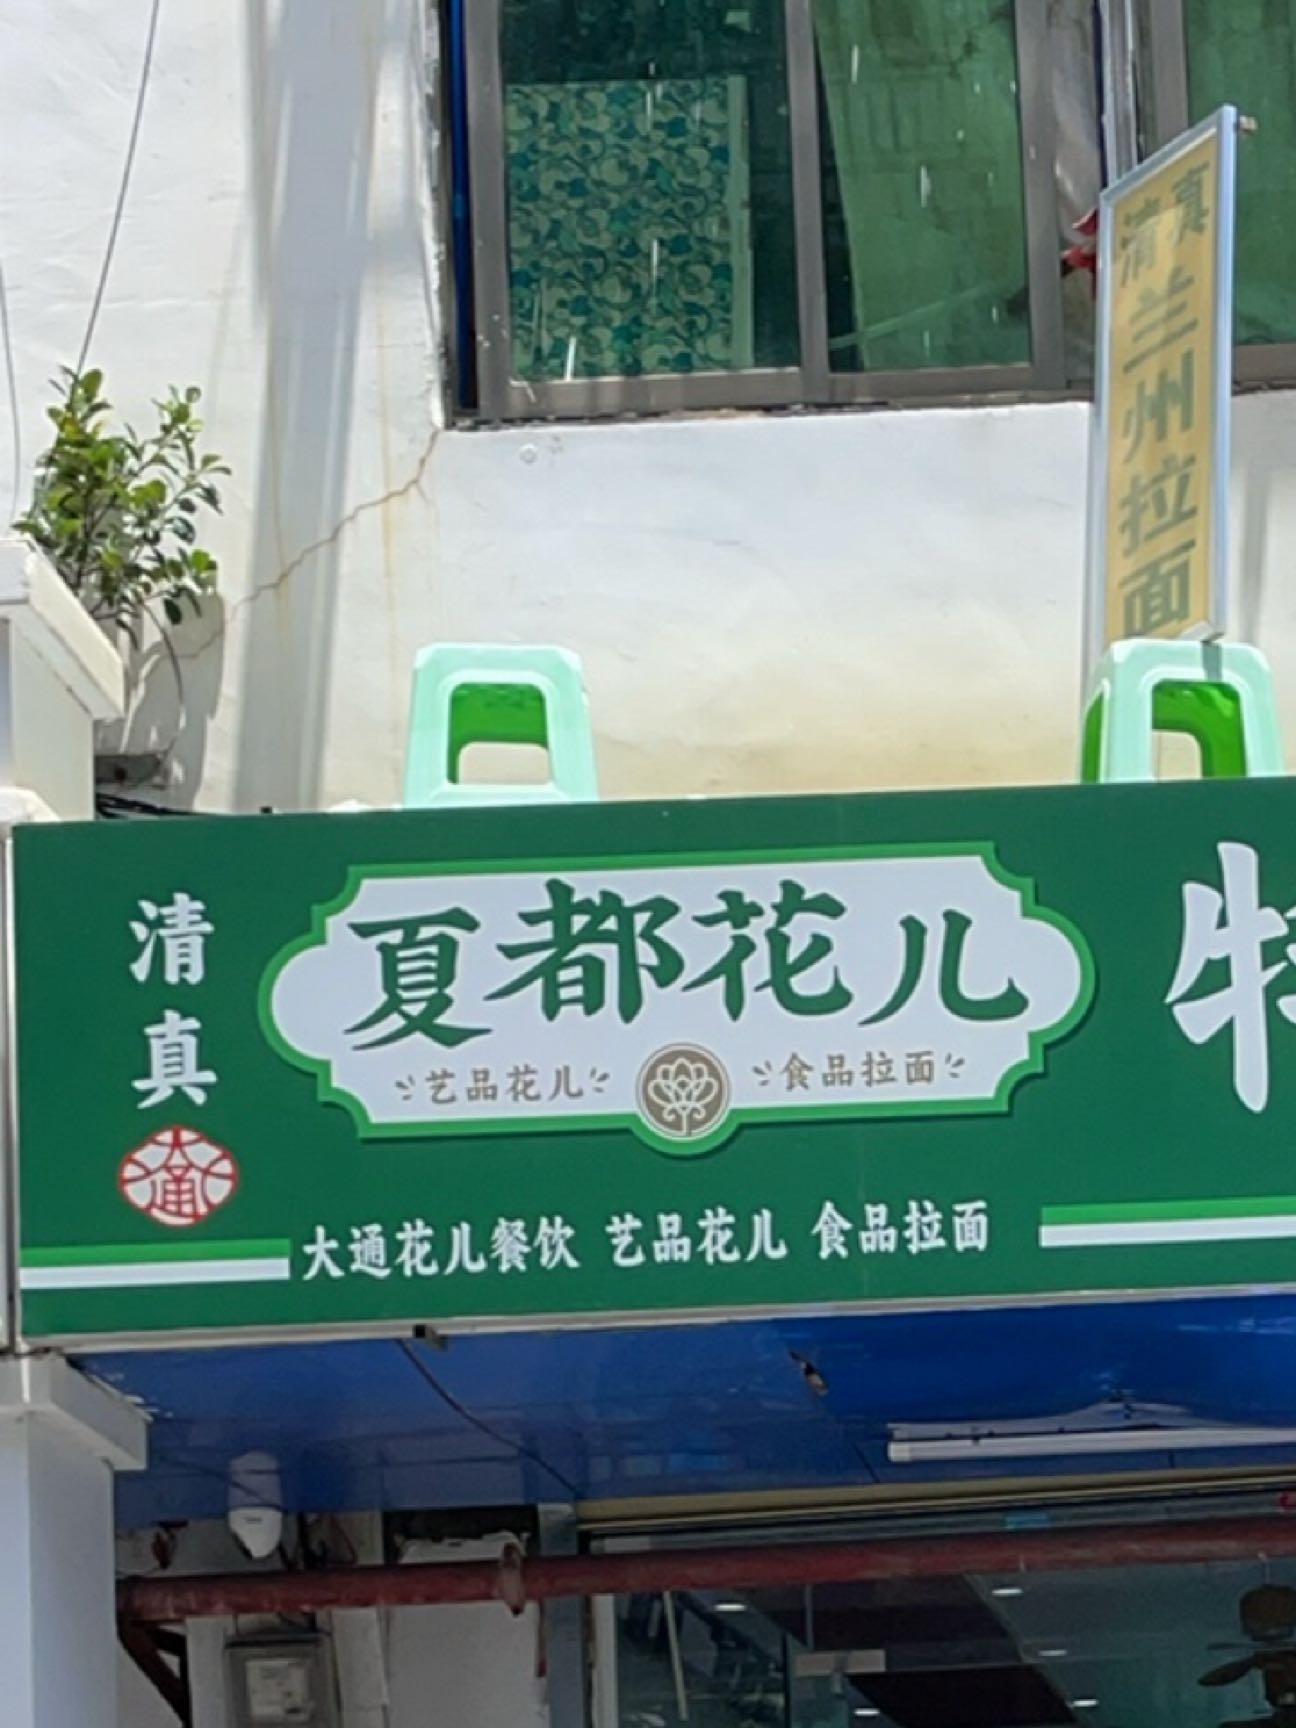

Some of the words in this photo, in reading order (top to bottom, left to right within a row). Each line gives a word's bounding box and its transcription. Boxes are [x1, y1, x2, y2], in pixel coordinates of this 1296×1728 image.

[1120, 264, 1201, 640] 兰州拉面
[129, 892, 217, 1110] 清真
[344, 877, 1030, 1050] 夏都花儿
[425, 1064, 585, 1104] 艺品花儿
[781, 1049, 934, 1091] 食品拉面
[301, 1217, 579, 1282] 大通花儿餐饮
[608, 1206, 788, 1265] 艺品花儿
[811, 1196, 990, 1260] 食品拉面
